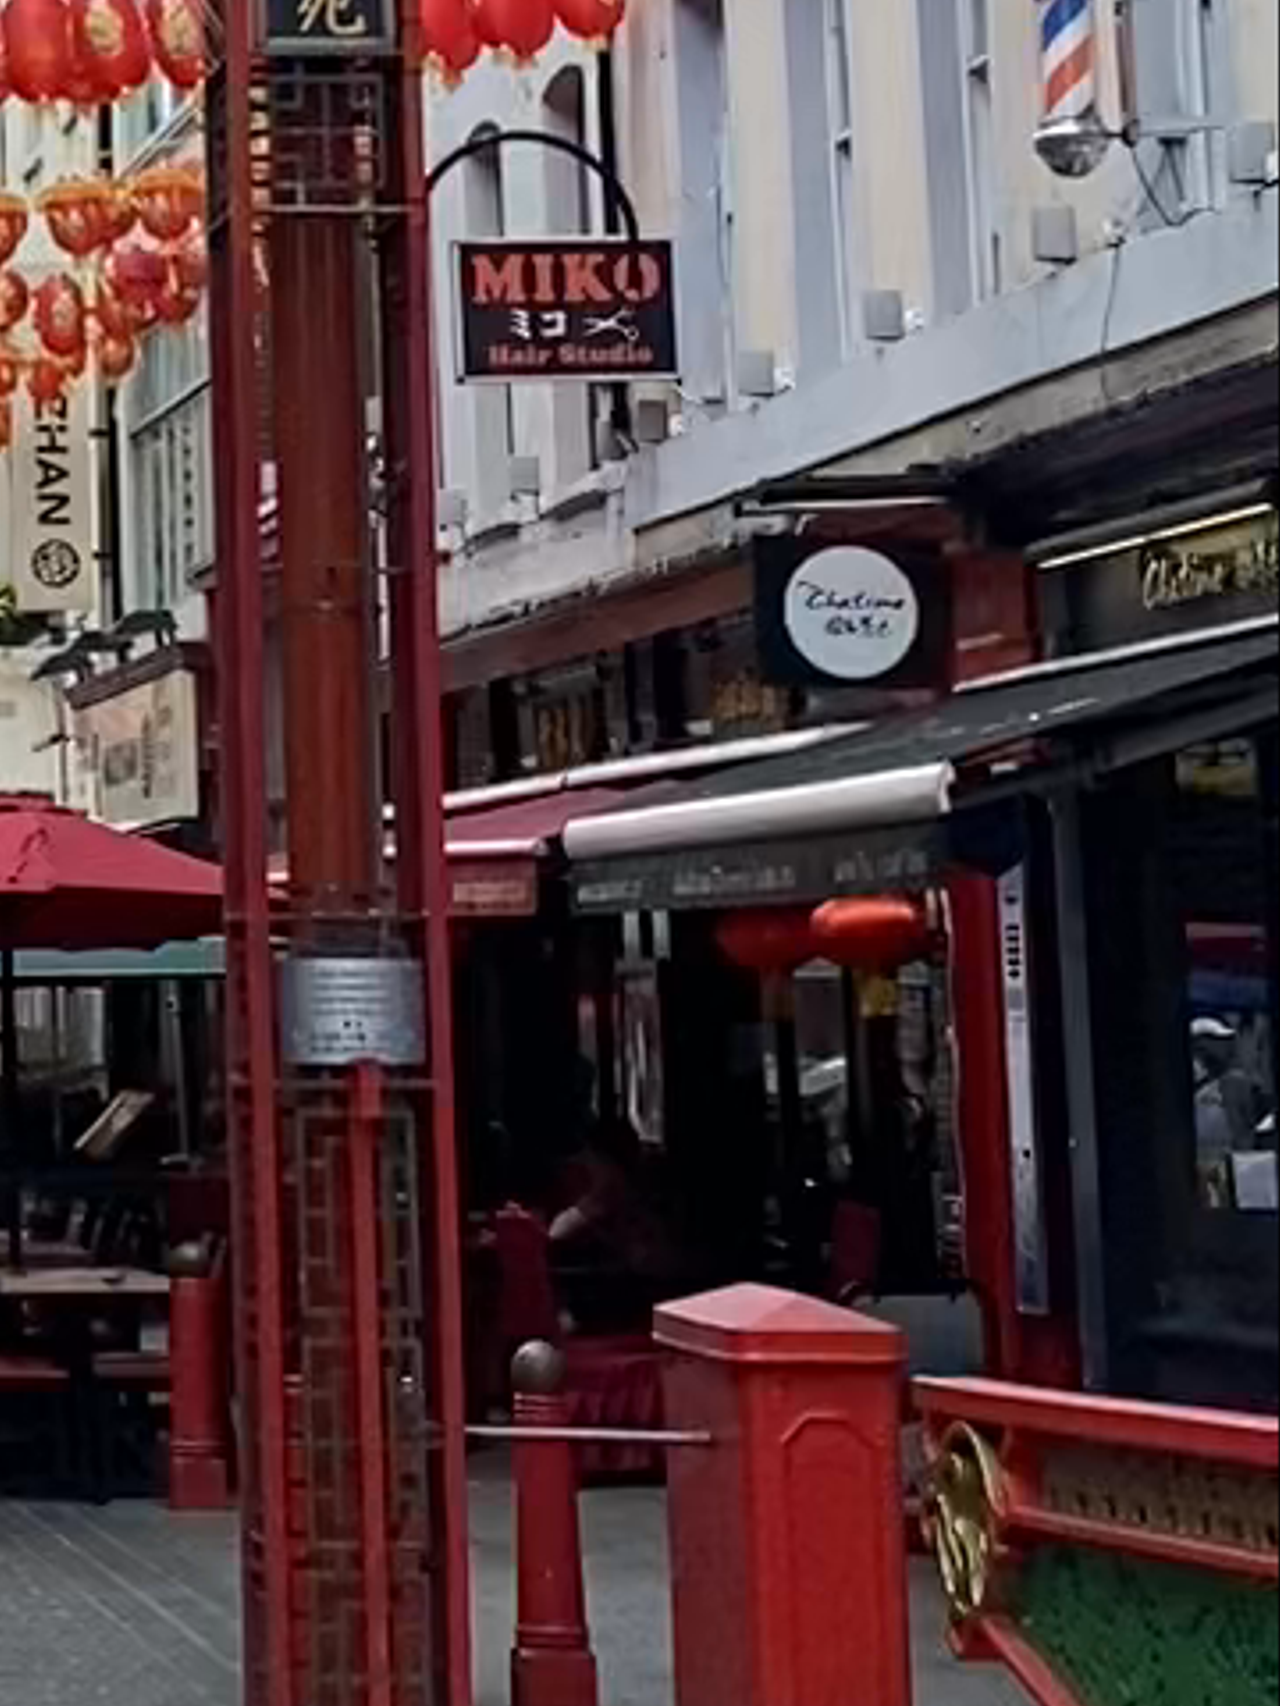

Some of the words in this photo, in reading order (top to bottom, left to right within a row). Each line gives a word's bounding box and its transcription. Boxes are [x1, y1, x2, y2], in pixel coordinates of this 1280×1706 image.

[471, 252, 661, 305] MIKO
[488, 344, 550, 365] Hair
[557, 343, 654, 364] Studio
